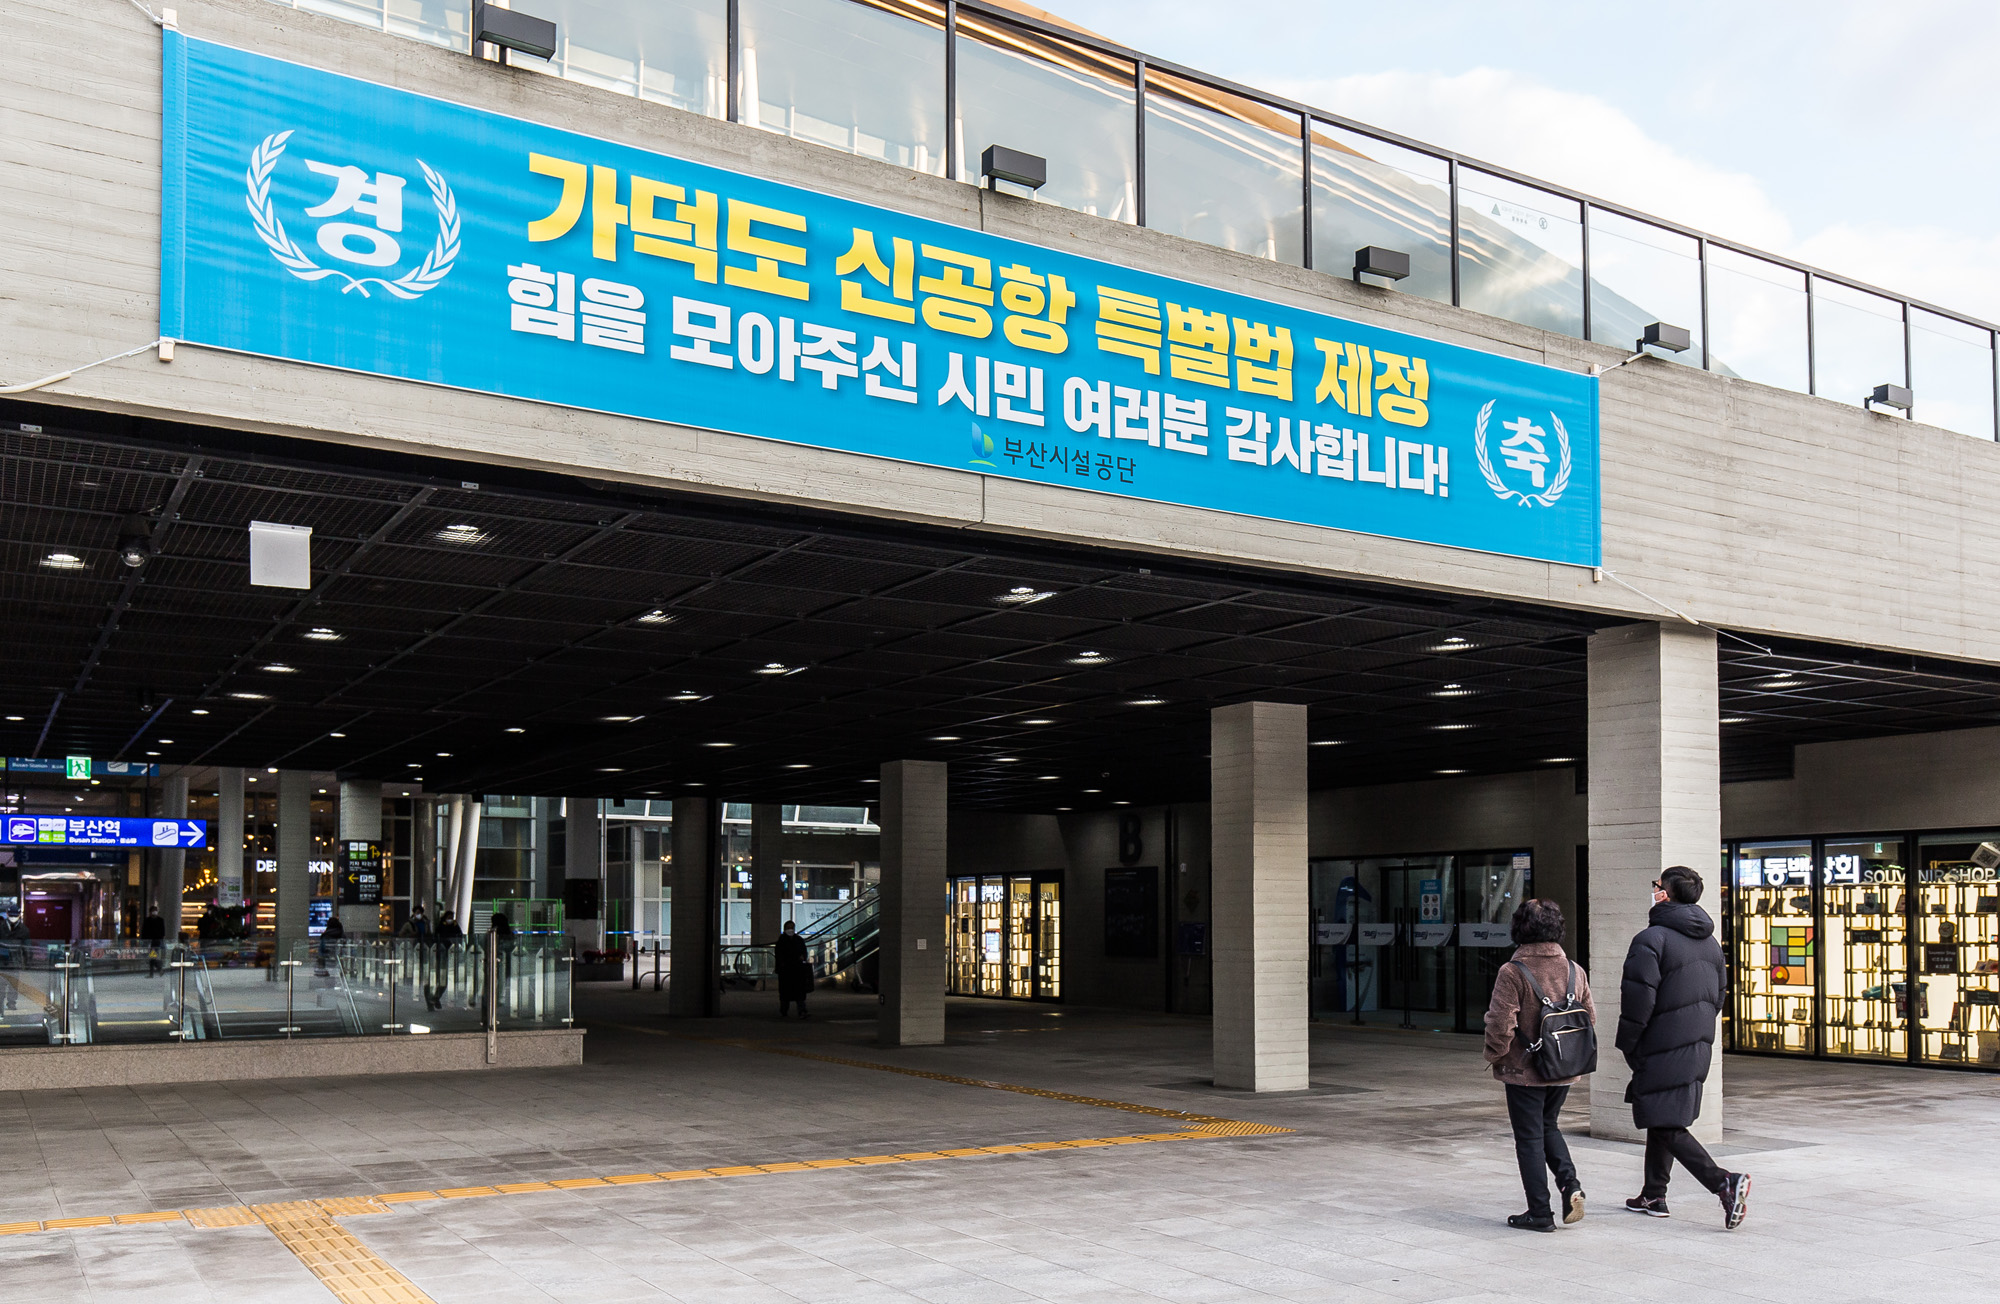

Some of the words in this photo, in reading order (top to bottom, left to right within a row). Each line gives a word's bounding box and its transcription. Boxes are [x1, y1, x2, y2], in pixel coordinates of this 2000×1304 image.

[304, 159, 407, 267] 경
[528, 152, 810, 301] 가덕도
[836, 227, 1076, 354] 신공항
[1095, 285, 1294, 402] 특별법
[1314, 337, 1430, 428] 제정
[507, 263, 646, 354] 힘을
[670, 296, 918, 404] 모아주신
[938, 352, 1045, 427] 시민
[1063, 376, 1209, 456] 여러분
[1225, 406, 1449, 498] 감사합니다!
[1003, 437, 1137, 484] 부산시설공단
[1499, 416, 1551, 488] 축
[69, 819, 120, 837] 부산역
[1950, 867, 1996, 883] SHOP
